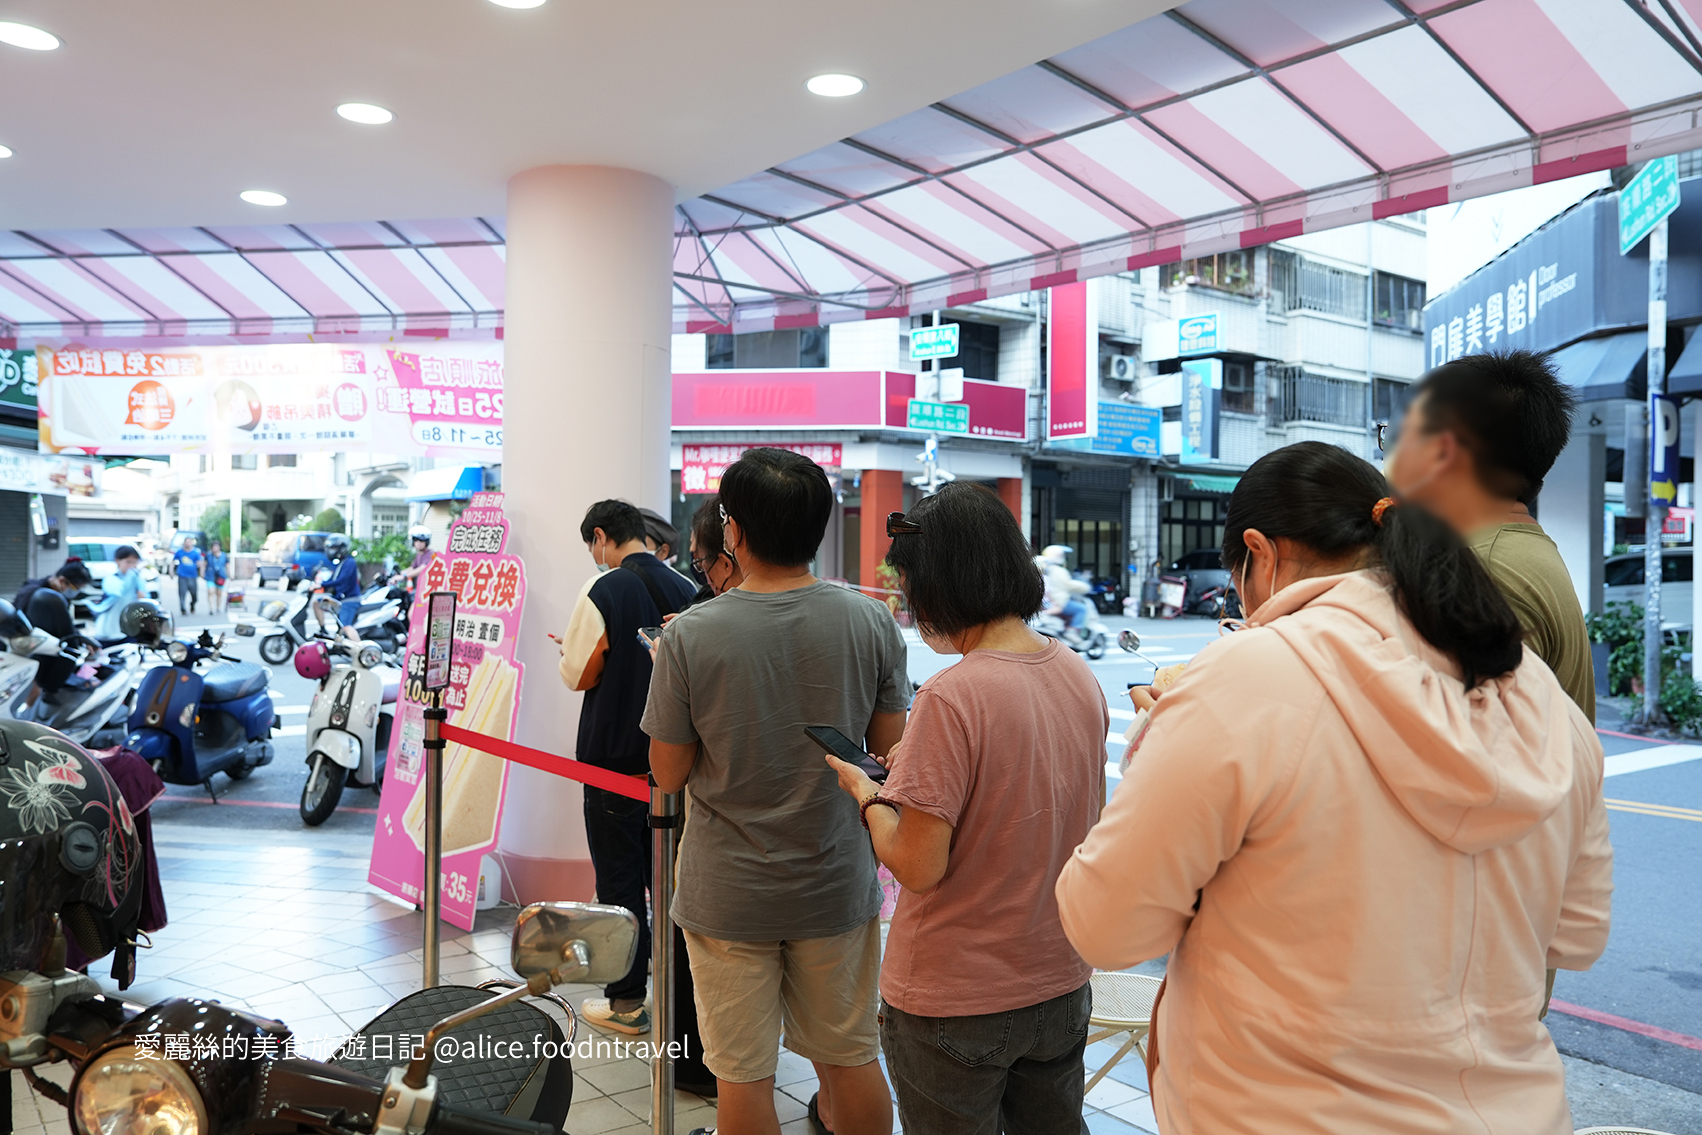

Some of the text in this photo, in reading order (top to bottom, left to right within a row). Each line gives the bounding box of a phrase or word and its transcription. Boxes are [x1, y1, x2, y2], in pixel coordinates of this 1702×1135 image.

[1653, 397, 1678, 473] P
[470, 494, 504, 508] 活動日期
[450, 525, 505, 553] 完成任務
[422, 558, 520, 609] 免費兌換
[478, 622, 501, 642] 壹個
[446, 686, 465, 707] 為止
